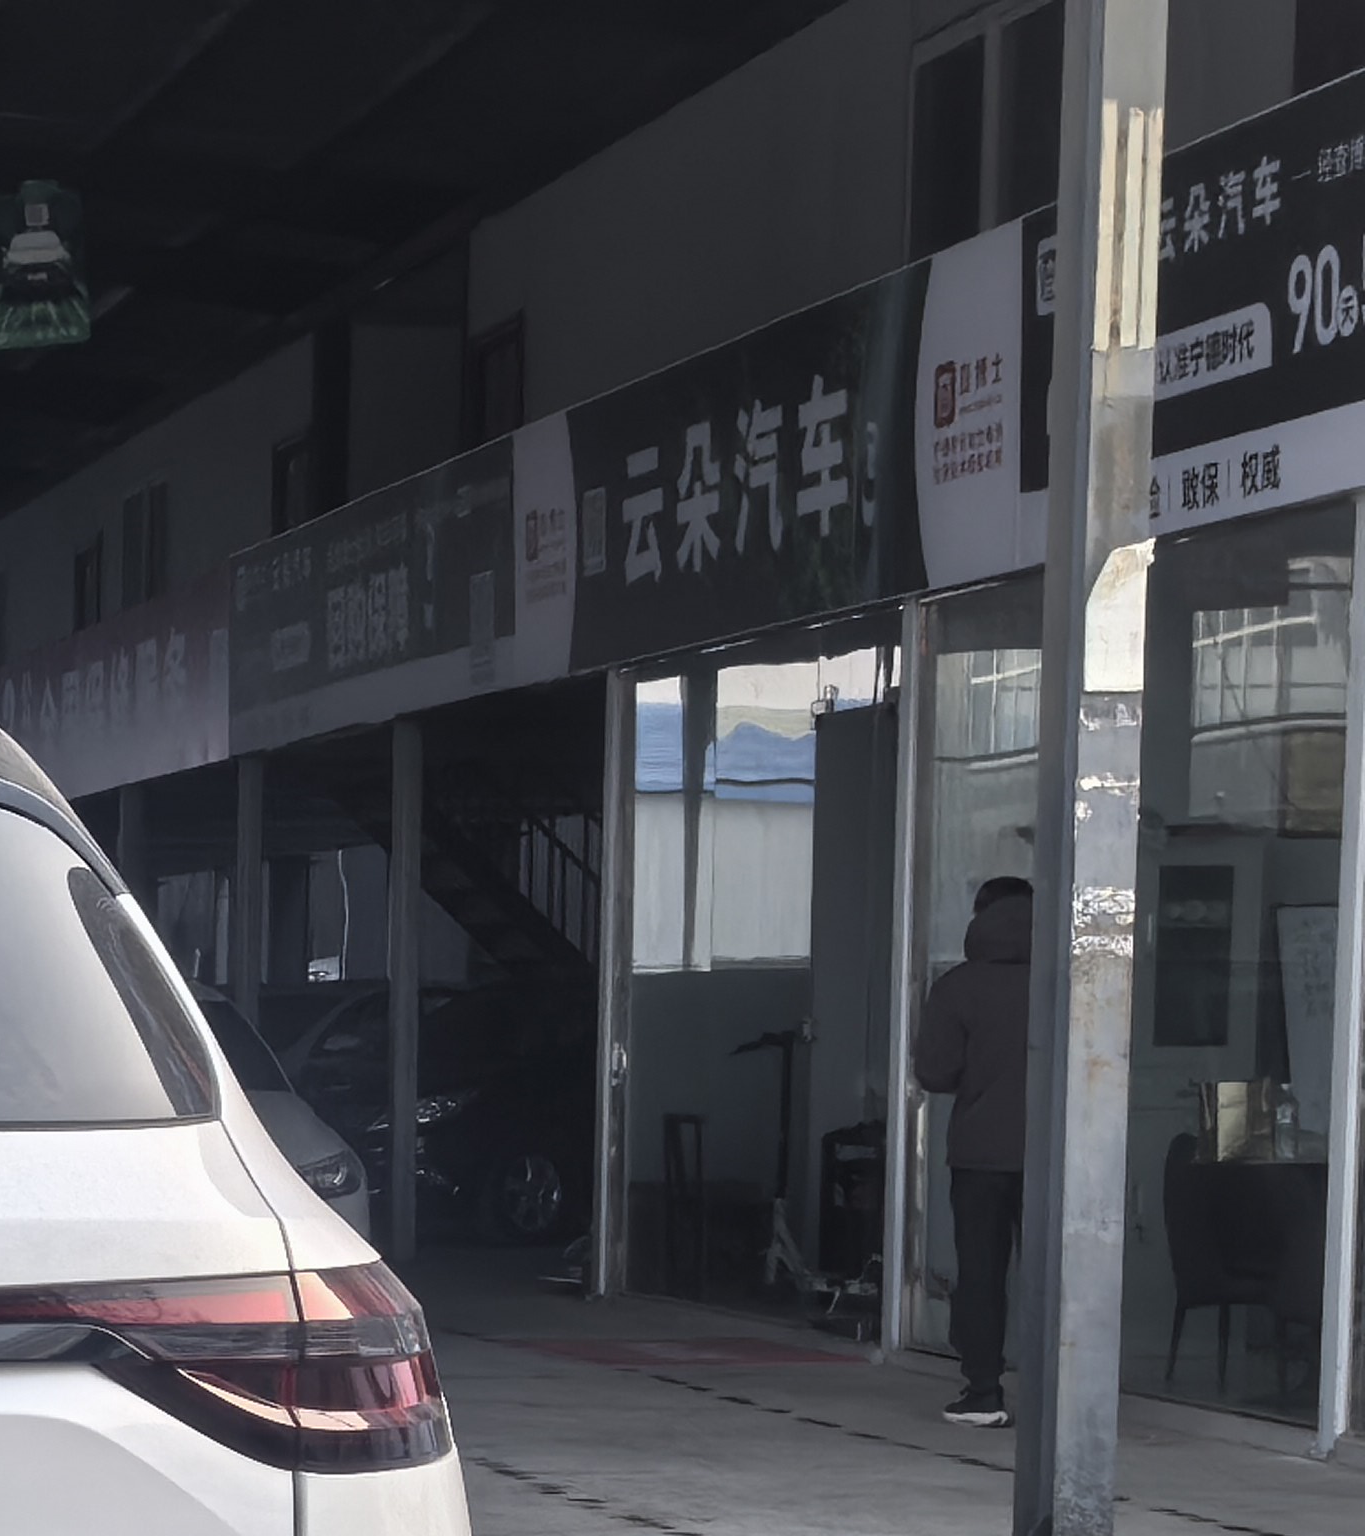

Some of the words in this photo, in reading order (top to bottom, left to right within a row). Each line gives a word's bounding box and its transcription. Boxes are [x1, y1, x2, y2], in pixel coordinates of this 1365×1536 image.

[1159, 156, 1281, 262] 云朵汽车
[1288, 233, 1365, 355] 90天
[621, 374, 850, 587] 云朵汽车
[1241, 444, 1281, 498] 权威
